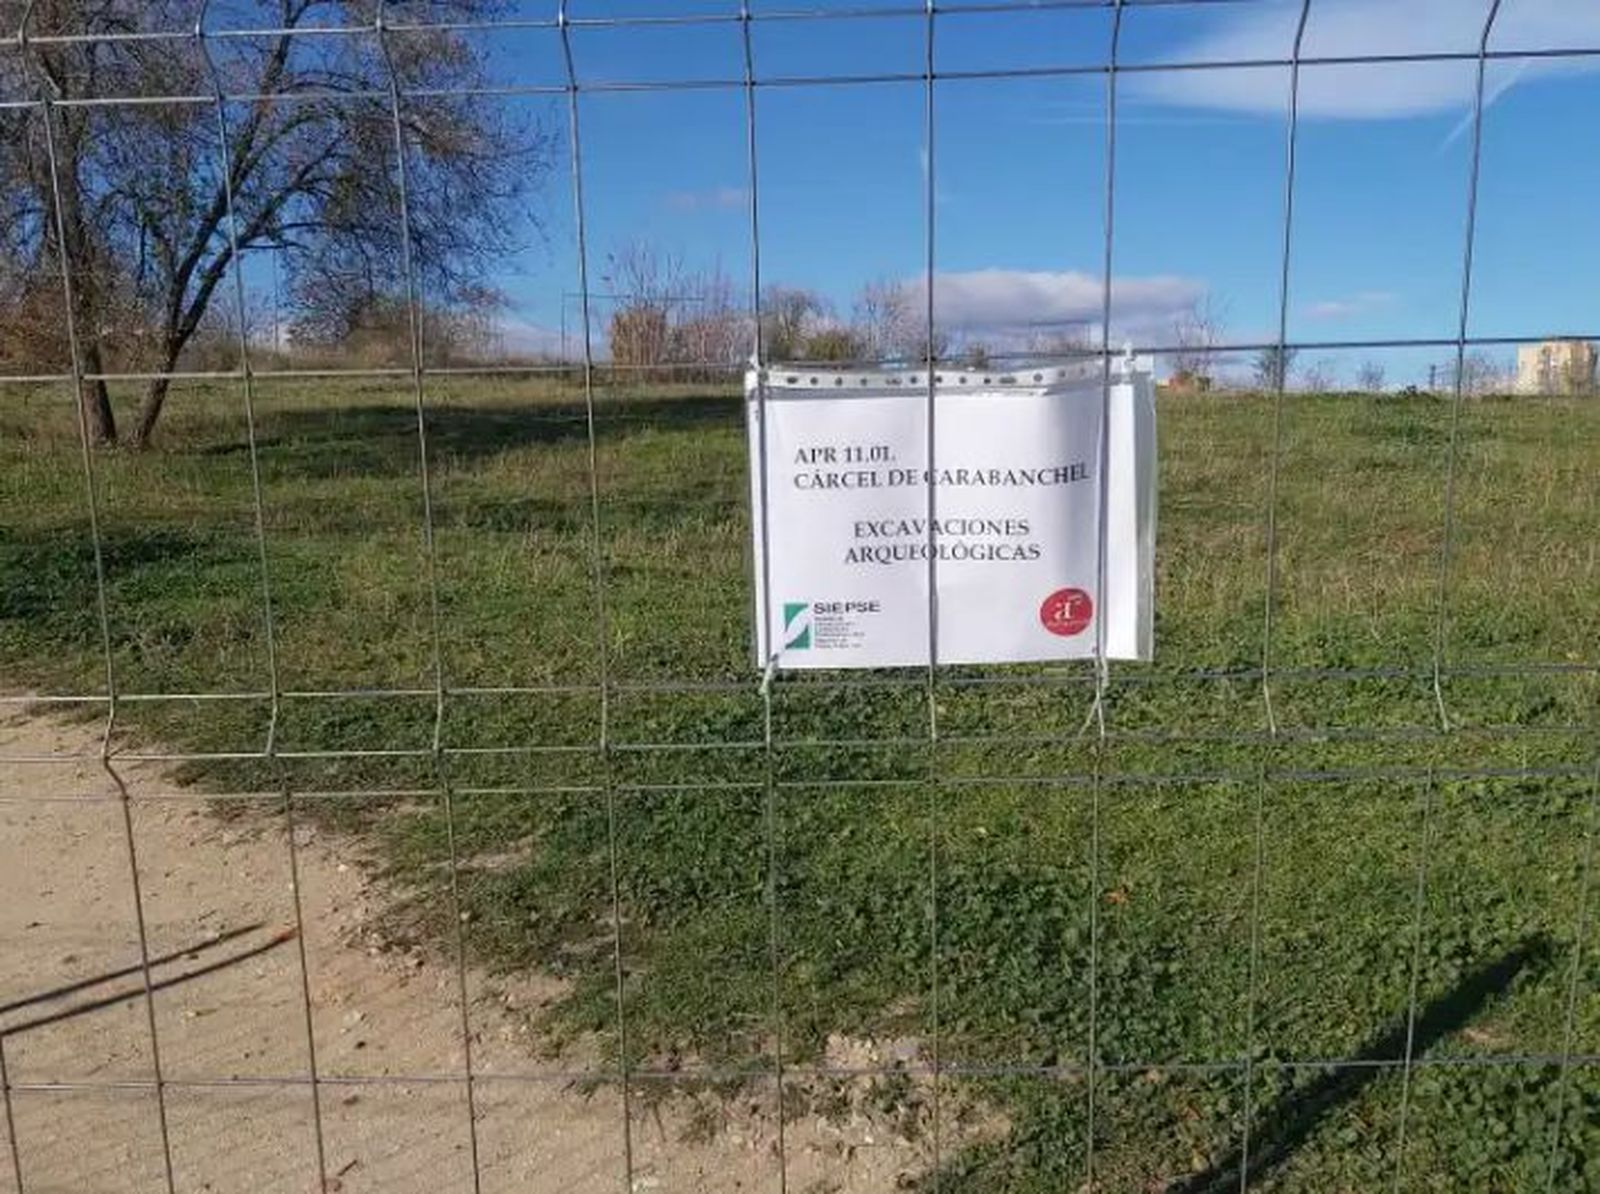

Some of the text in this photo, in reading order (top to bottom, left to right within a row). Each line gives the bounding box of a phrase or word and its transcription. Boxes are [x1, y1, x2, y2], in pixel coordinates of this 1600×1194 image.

[794, 445, 837, 464] APR
[794, 467, 882, 490] CÁRCEL
[887, 468, 918, 487] DE
[853, 518, 1030, 539] EXCAVACIONES
[844, 540, 1041, 565] ARQUEOLÓGICAS
[813, 601, 881, 614] SIEPSE
